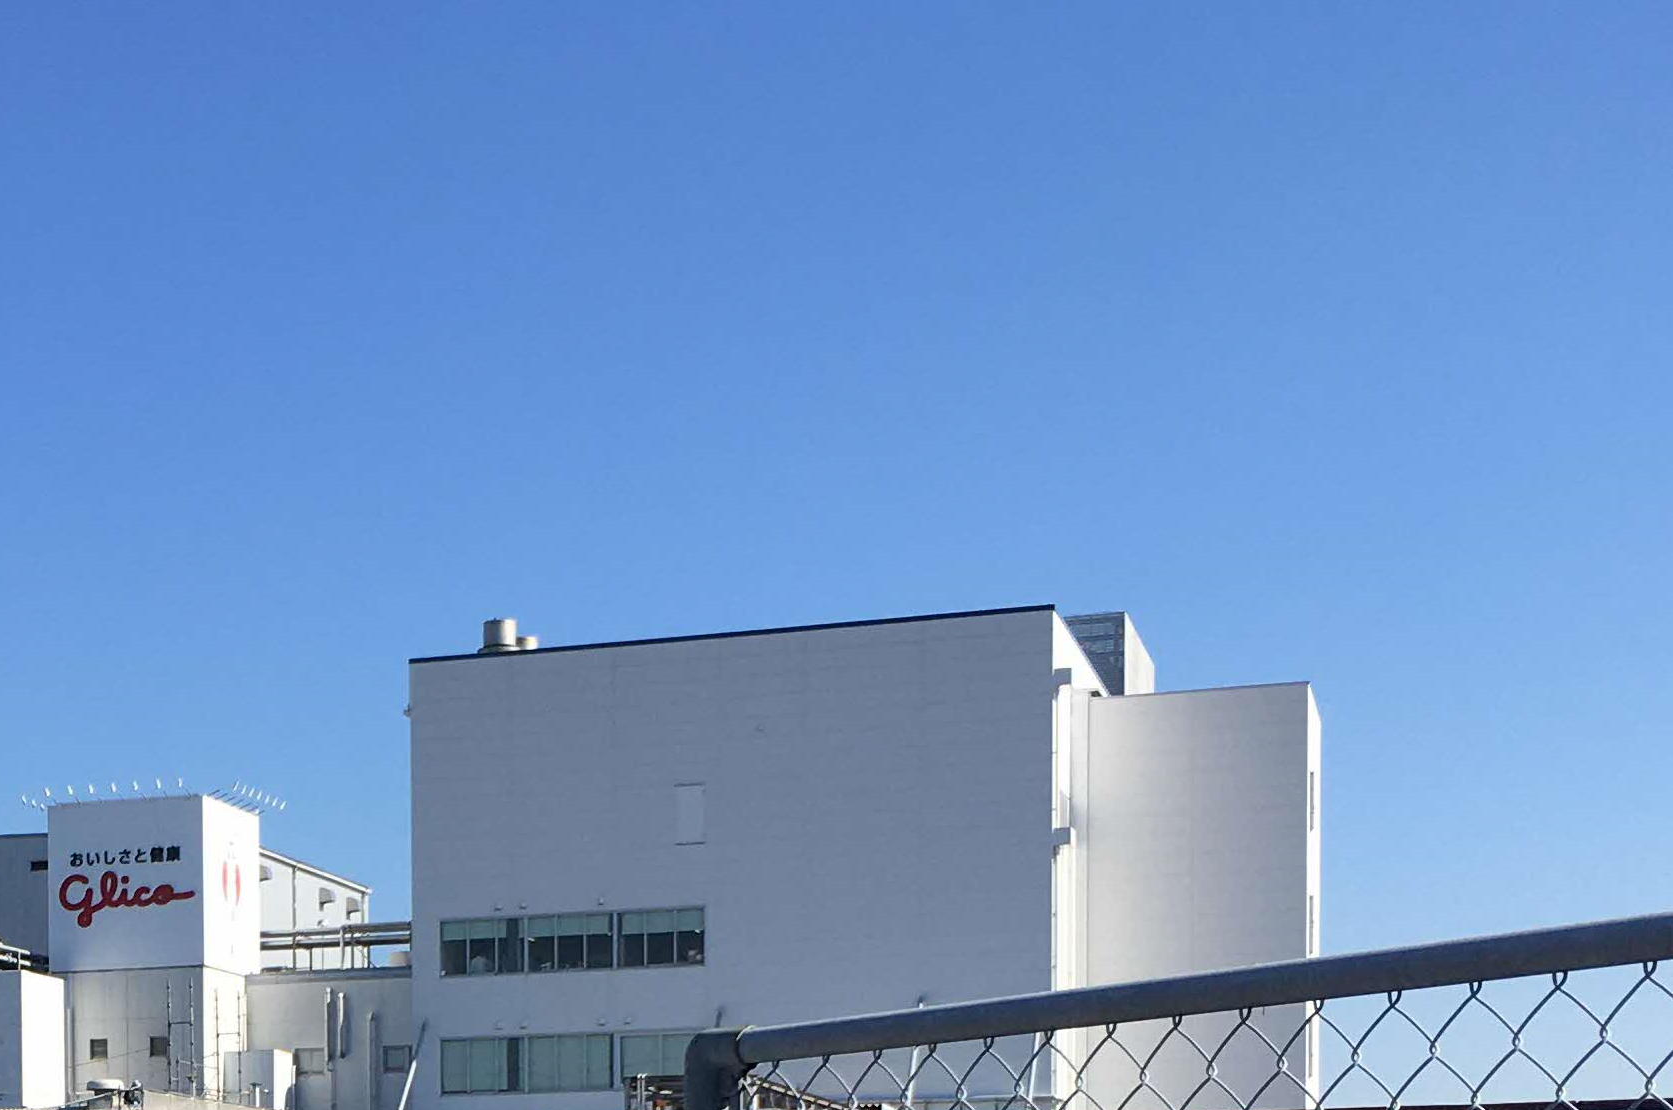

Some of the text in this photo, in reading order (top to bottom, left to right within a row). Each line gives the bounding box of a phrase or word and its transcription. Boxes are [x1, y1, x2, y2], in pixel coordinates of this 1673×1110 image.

[70, 845, 181, 867] おいしさと健康
[59, 870, 195, 928] Glico
